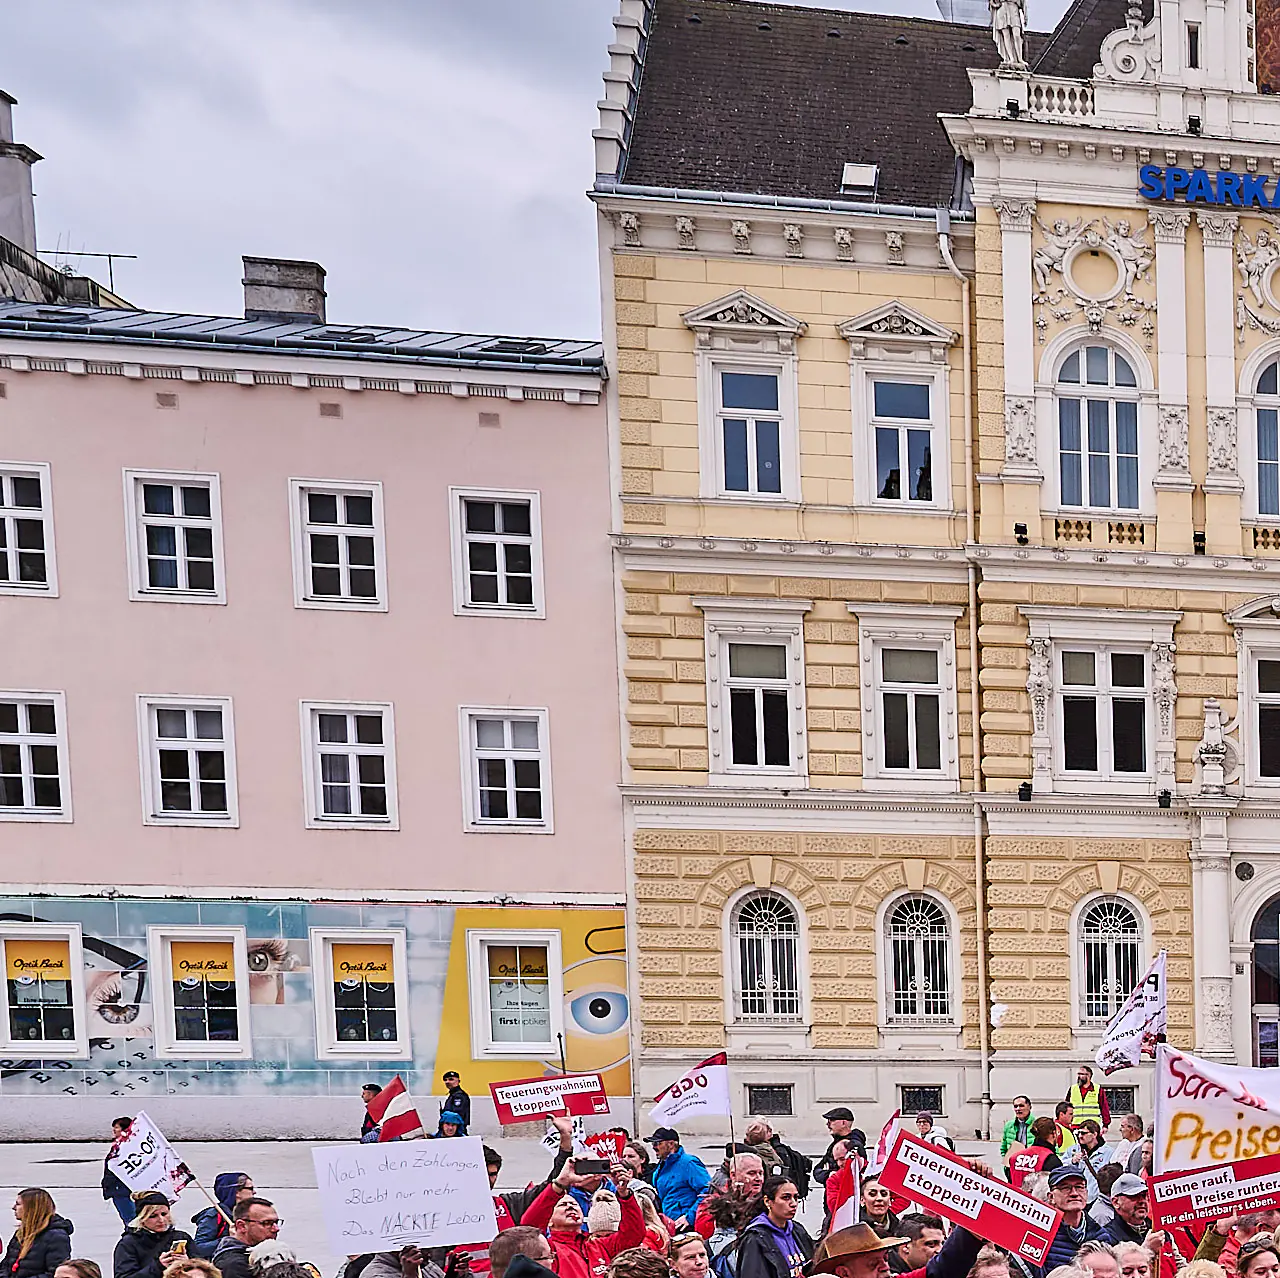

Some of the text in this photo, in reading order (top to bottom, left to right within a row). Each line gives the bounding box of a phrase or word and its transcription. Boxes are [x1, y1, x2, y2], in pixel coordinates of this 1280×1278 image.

[499, 964, 519, 975] Opti
[498, 1078, 598, 1101] Teuerungswahnsinn
[513, 1098, 561, 1113] stoppen!
[378, 1155, 409, 1173] den
[1015, 1154, 1040, 1168] SPÖ
[904, 1145, 1051, 1225] Teuerungswahnsinn
[908, 1172, 978, 1212] stoppen!
[1158, 1171, 1233, 1199] Löhne rauf,
[1194, 1188, 1235, 1207] Preise
[1244, 1196, 1277, 1211] Leben.
[446, 1212, 486, 1228] Leben
